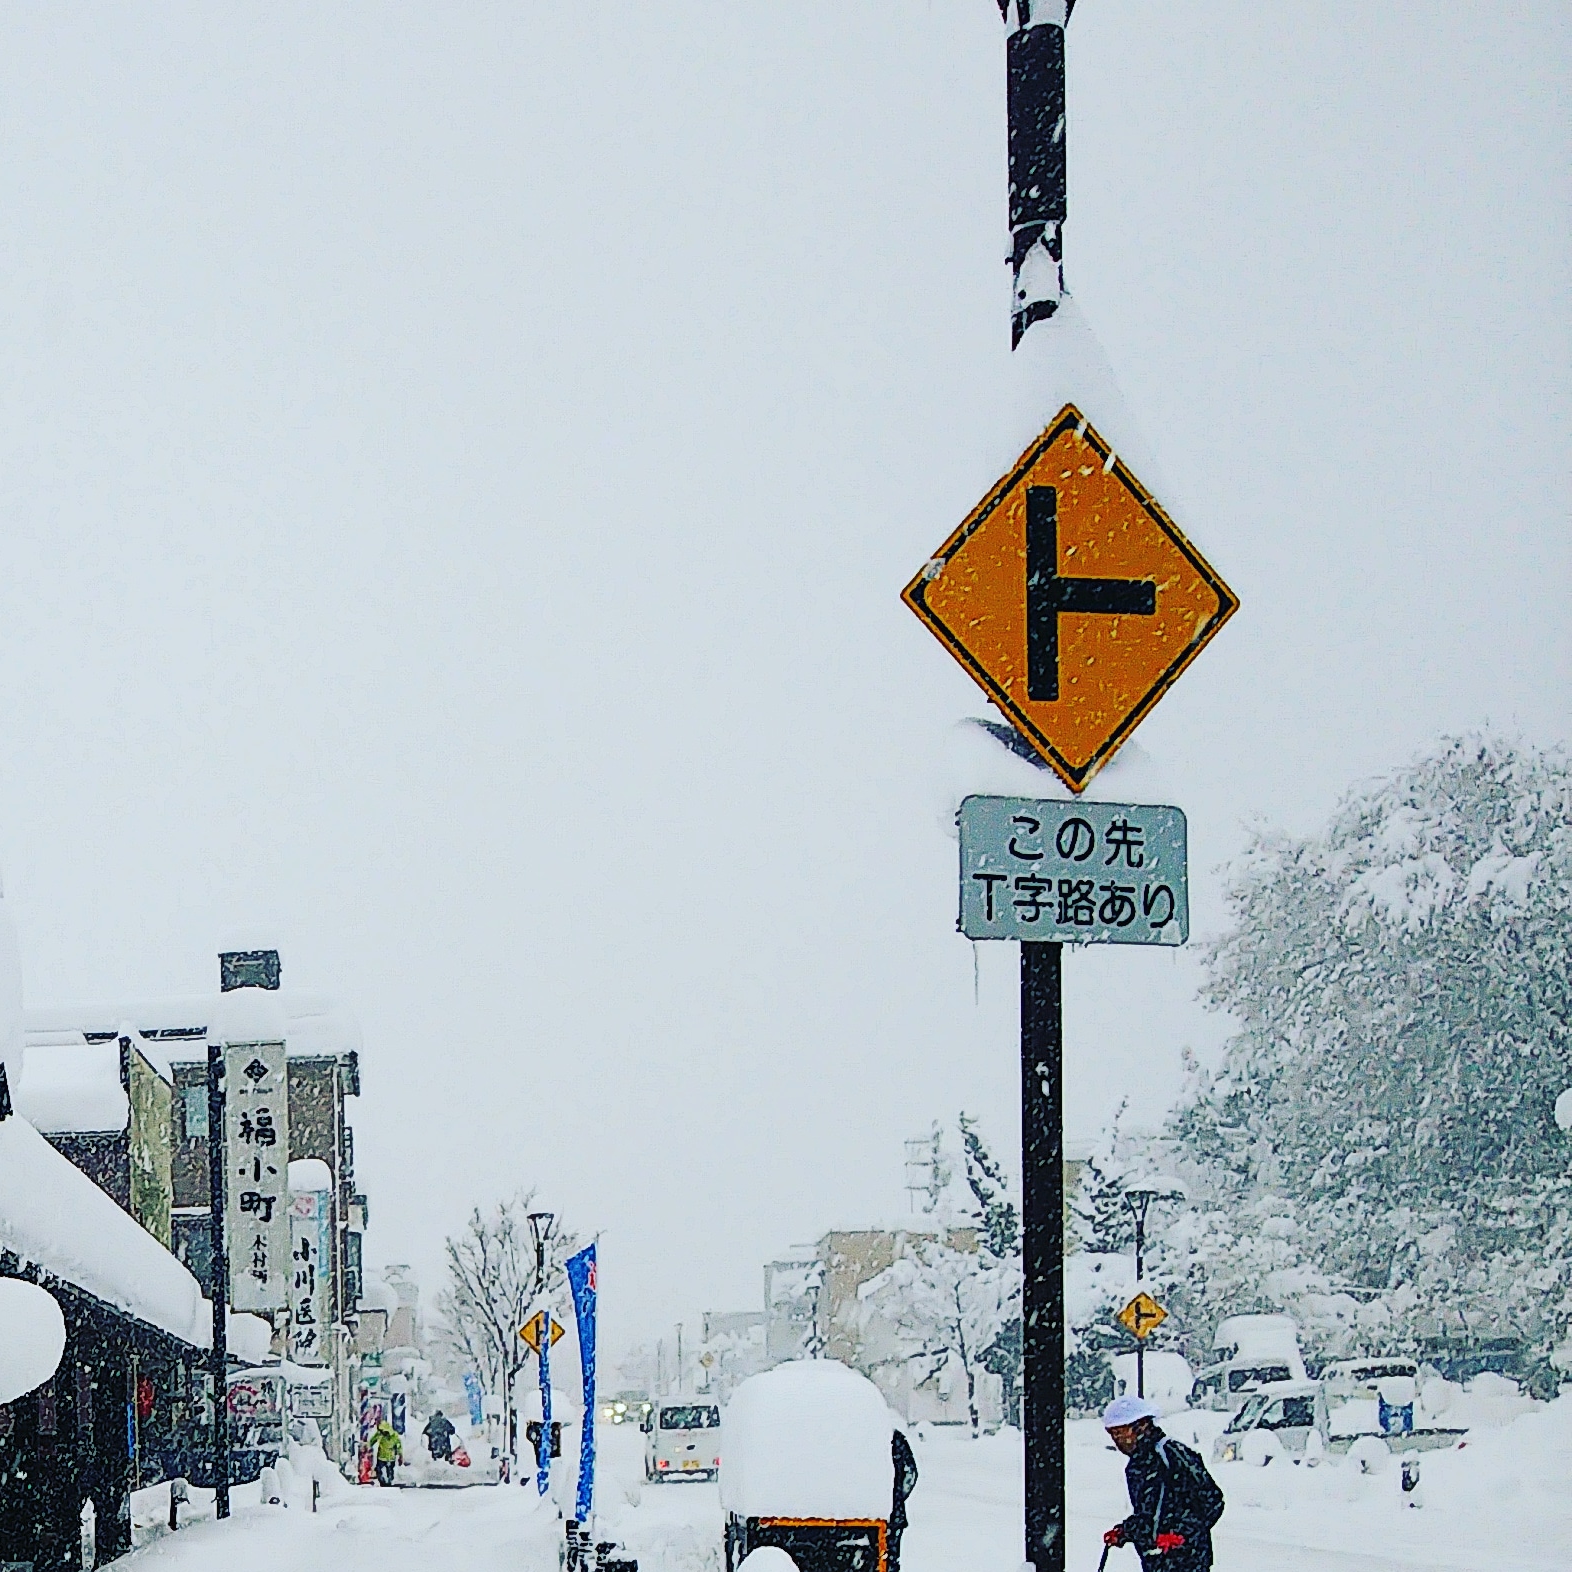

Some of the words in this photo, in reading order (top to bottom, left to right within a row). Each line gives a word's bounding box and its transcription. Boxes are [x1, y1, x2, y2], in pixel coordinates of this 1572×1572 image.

[1008, 815, 1144, 868] この先
[972, 873, 1175, 928] T字路あり
[238, 1107, 277, 1222] 福小町
